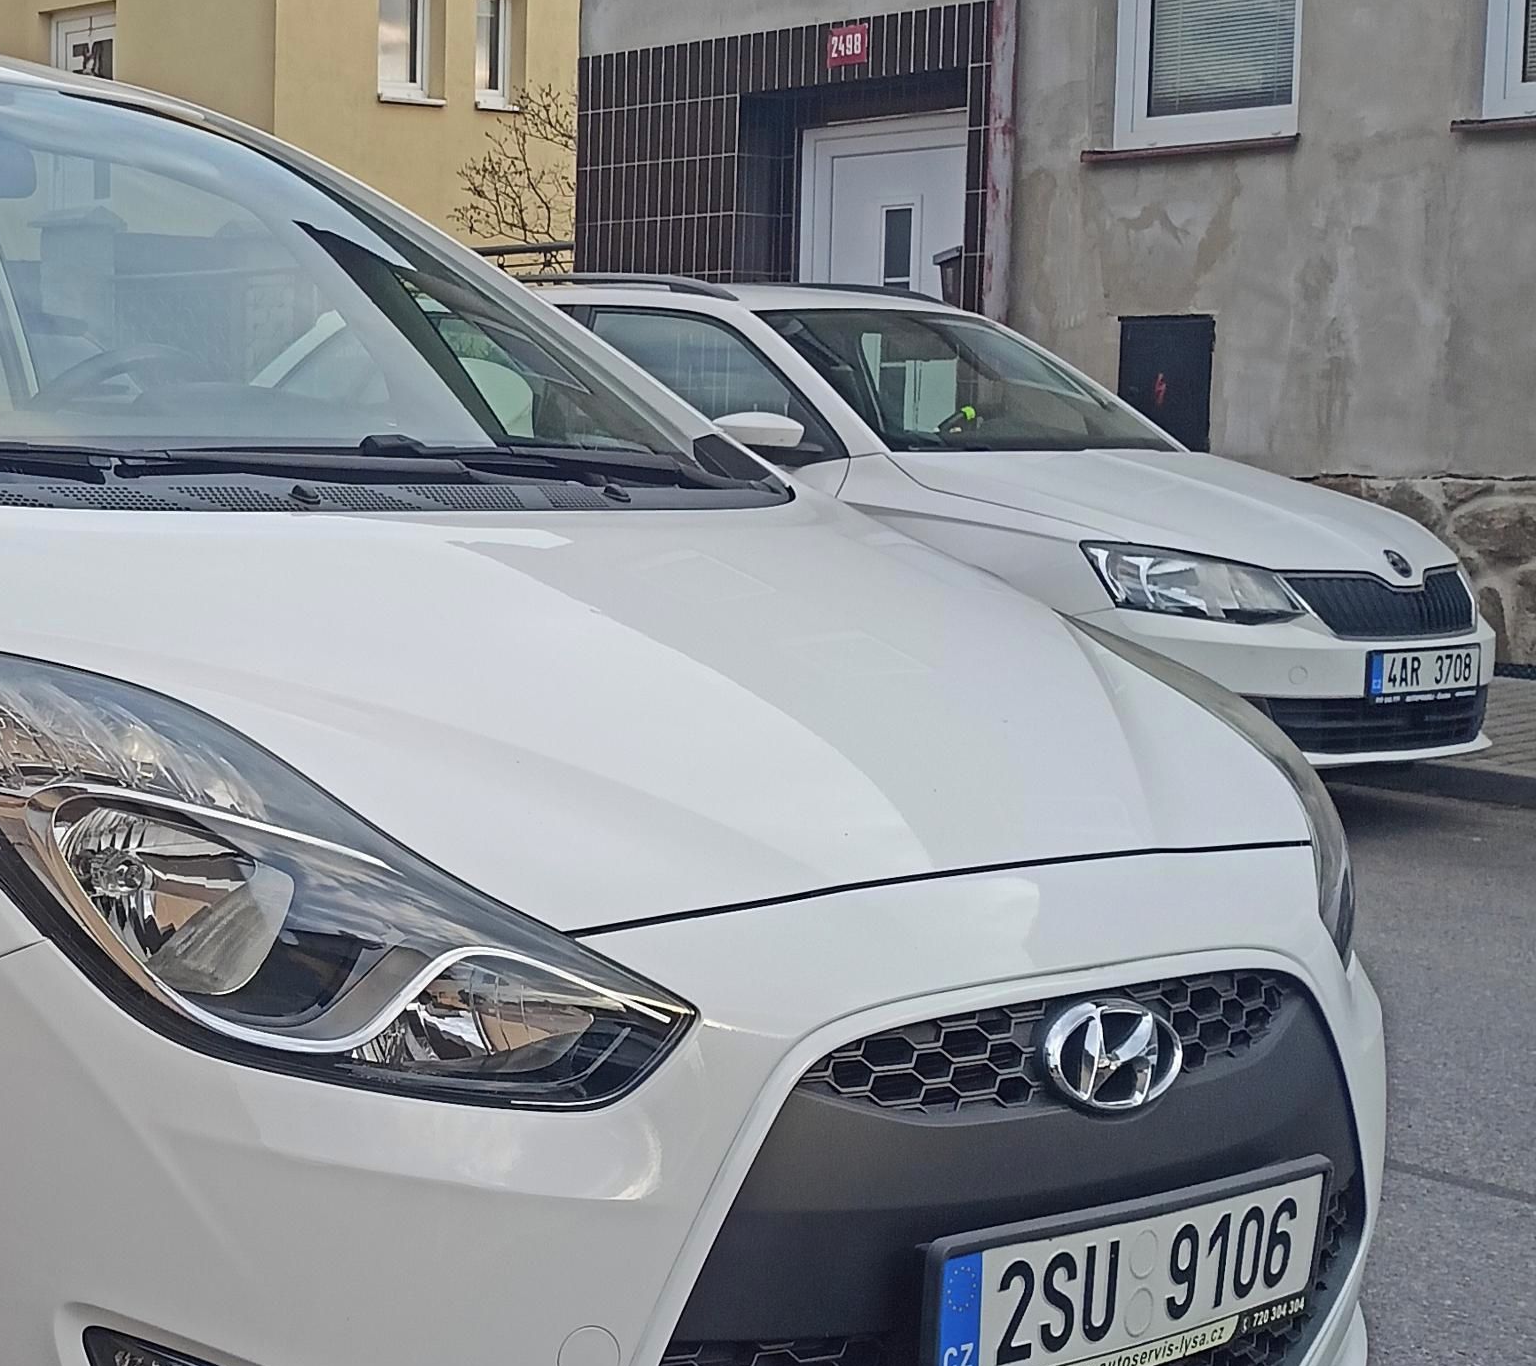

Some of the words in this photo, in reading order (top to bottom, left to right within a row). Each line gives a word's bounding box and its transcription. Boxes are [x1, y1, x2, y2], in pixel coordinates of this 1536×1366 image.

[831, 33, 862, 58] 2498
[1388, 656, 1421, 688] 4AR
[1435, 652, 1472, 684] 3708
[995, 1240, 1120, 1366] 2SU
[1166, 1197, 1297, 1320] 9106
